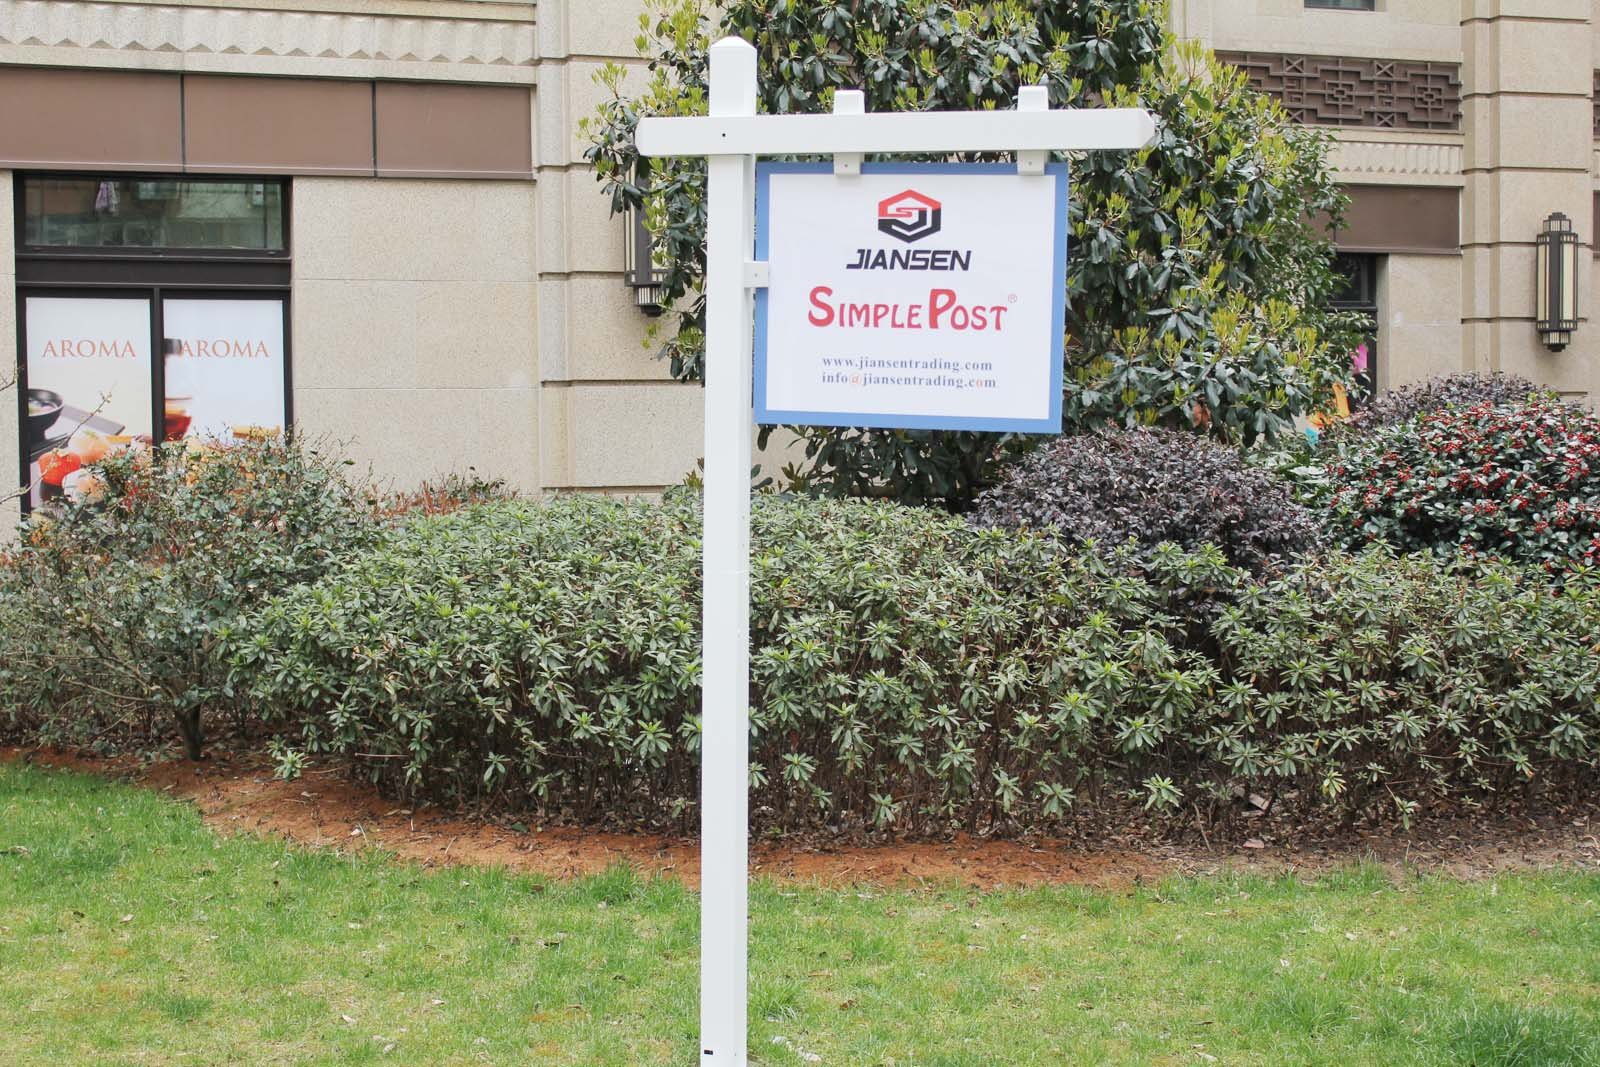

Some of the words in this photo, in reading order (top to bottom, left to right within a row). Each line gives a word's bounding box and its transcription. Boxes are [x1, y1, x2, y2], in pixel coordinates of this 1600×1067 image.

[846, 249, 972, 271] JIANSEN
[42, 339, 137, 359] AROMA
[180, 339, 270, 359] AROMA
[822, 356, 993, 371] www.jiansentrading.com
[821, 371, 997, 389] info@jiansentrading.com
